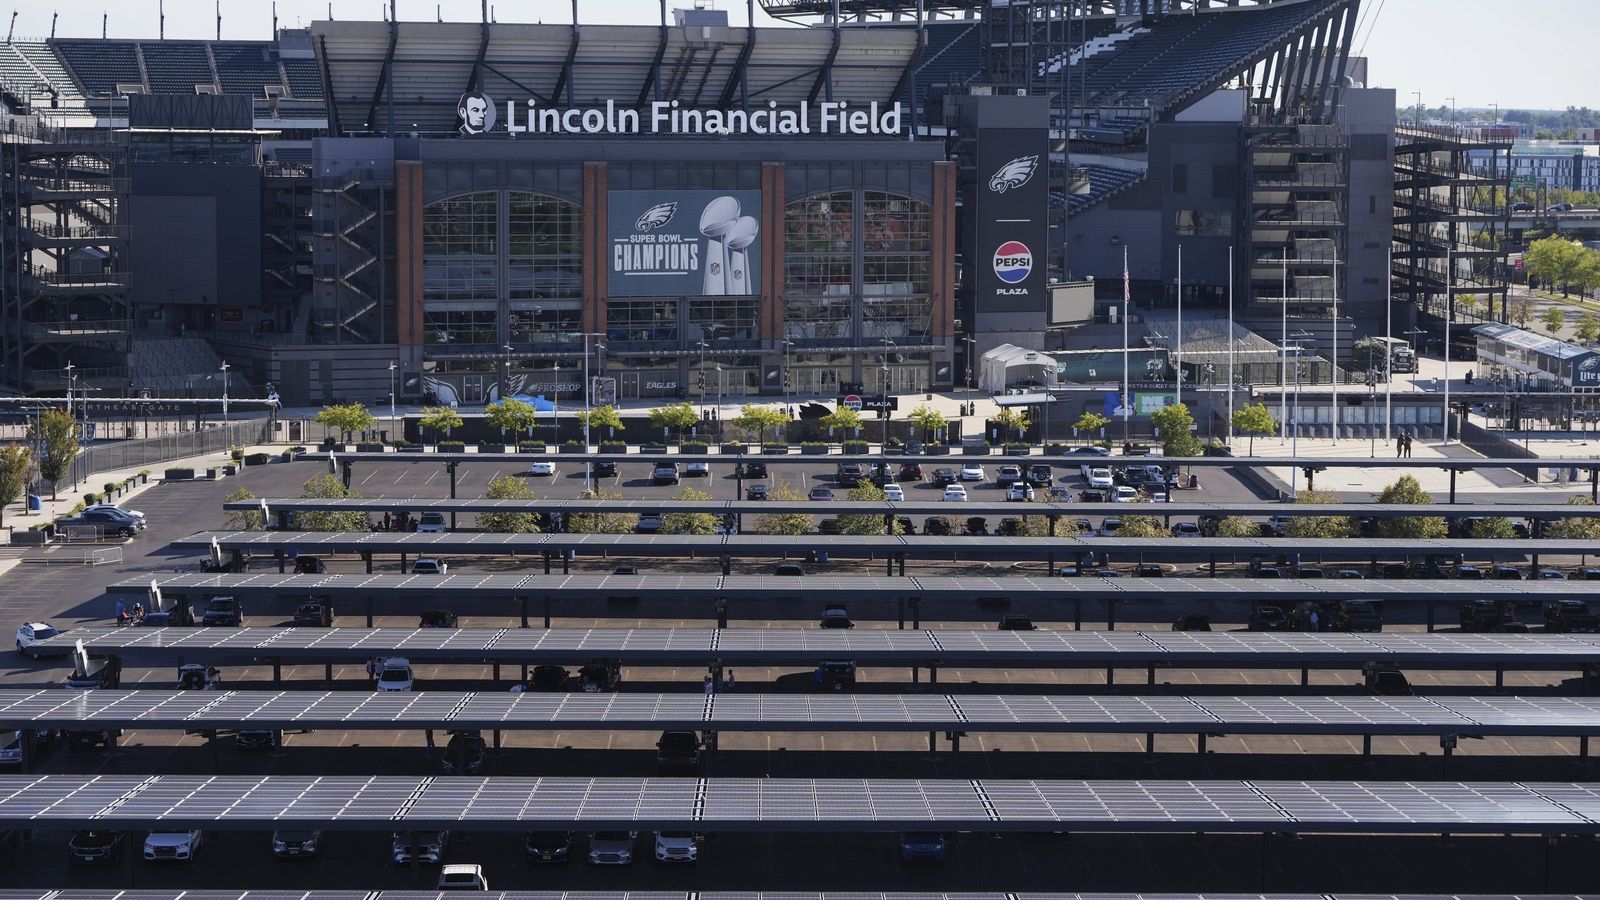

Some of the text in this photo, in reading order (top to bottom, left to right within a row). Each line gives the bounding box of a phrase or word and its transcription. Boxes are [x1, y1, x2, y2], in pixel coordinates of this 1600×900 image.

[507, 98, 901, 134] Lincoln Financial Field
[630, 234, 683, 243] SUPER BOWL
[613, 243, 699, 272] CHAMPIONS
[995, 257, 1030, 267] PEPSI
[1580, 371, 1596, 381] Lite
